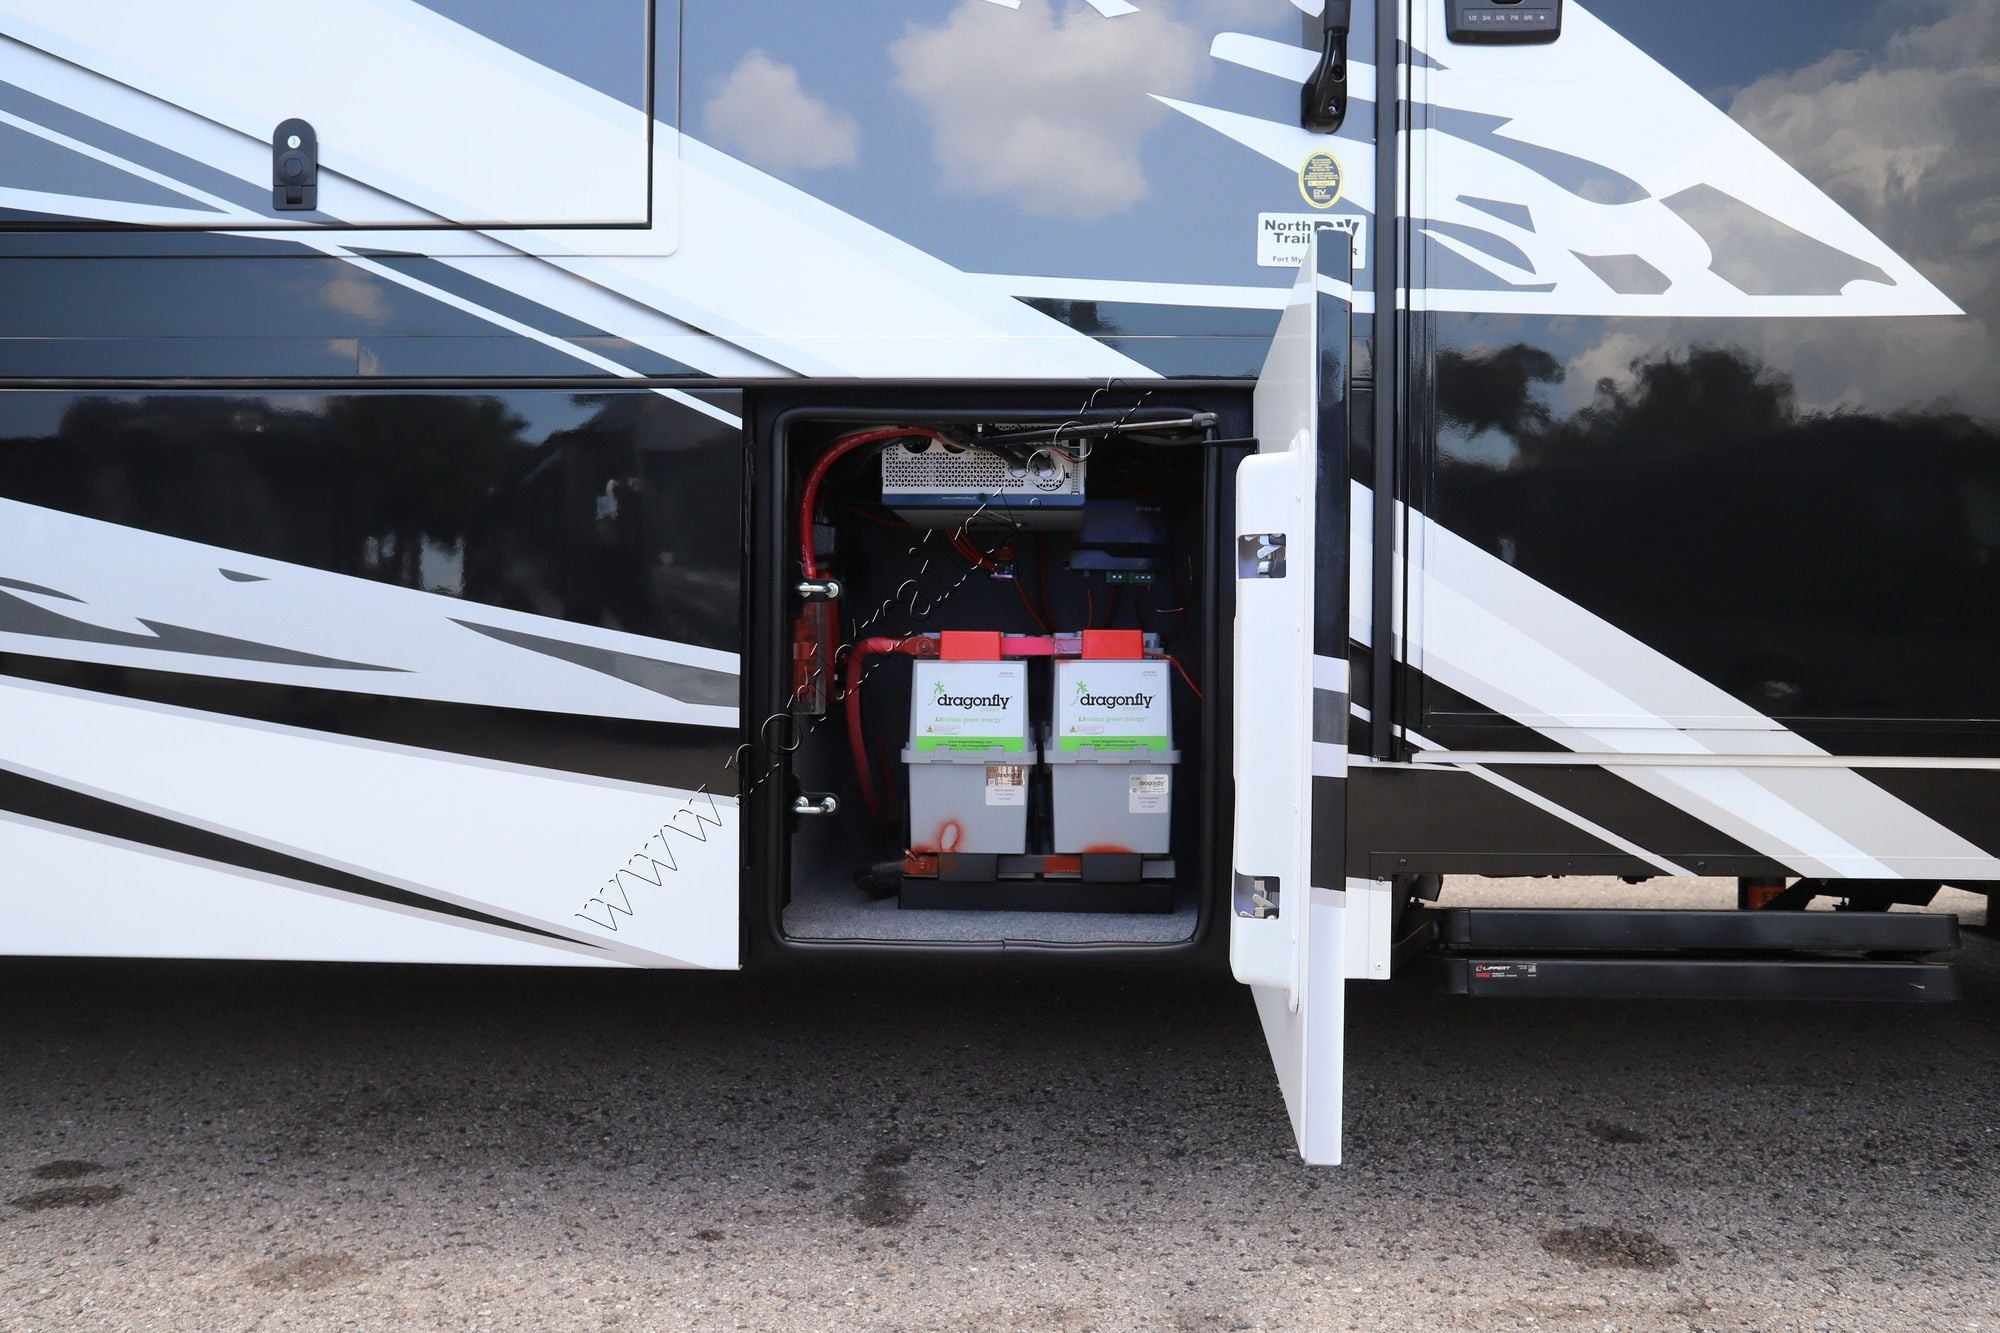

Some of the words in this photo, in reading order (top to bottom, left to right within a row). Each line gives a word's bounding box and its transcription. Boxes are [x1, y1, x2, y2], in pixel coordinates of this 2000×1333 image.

[1264, 219, 1312, 232] North
[1273, 232, 1311, 244] Trail
[1272, 255, 1289, 263] Fort
[937, 693, 1010, 710] dragonfly
[1080, 692, 1153, 709] dragonfly
